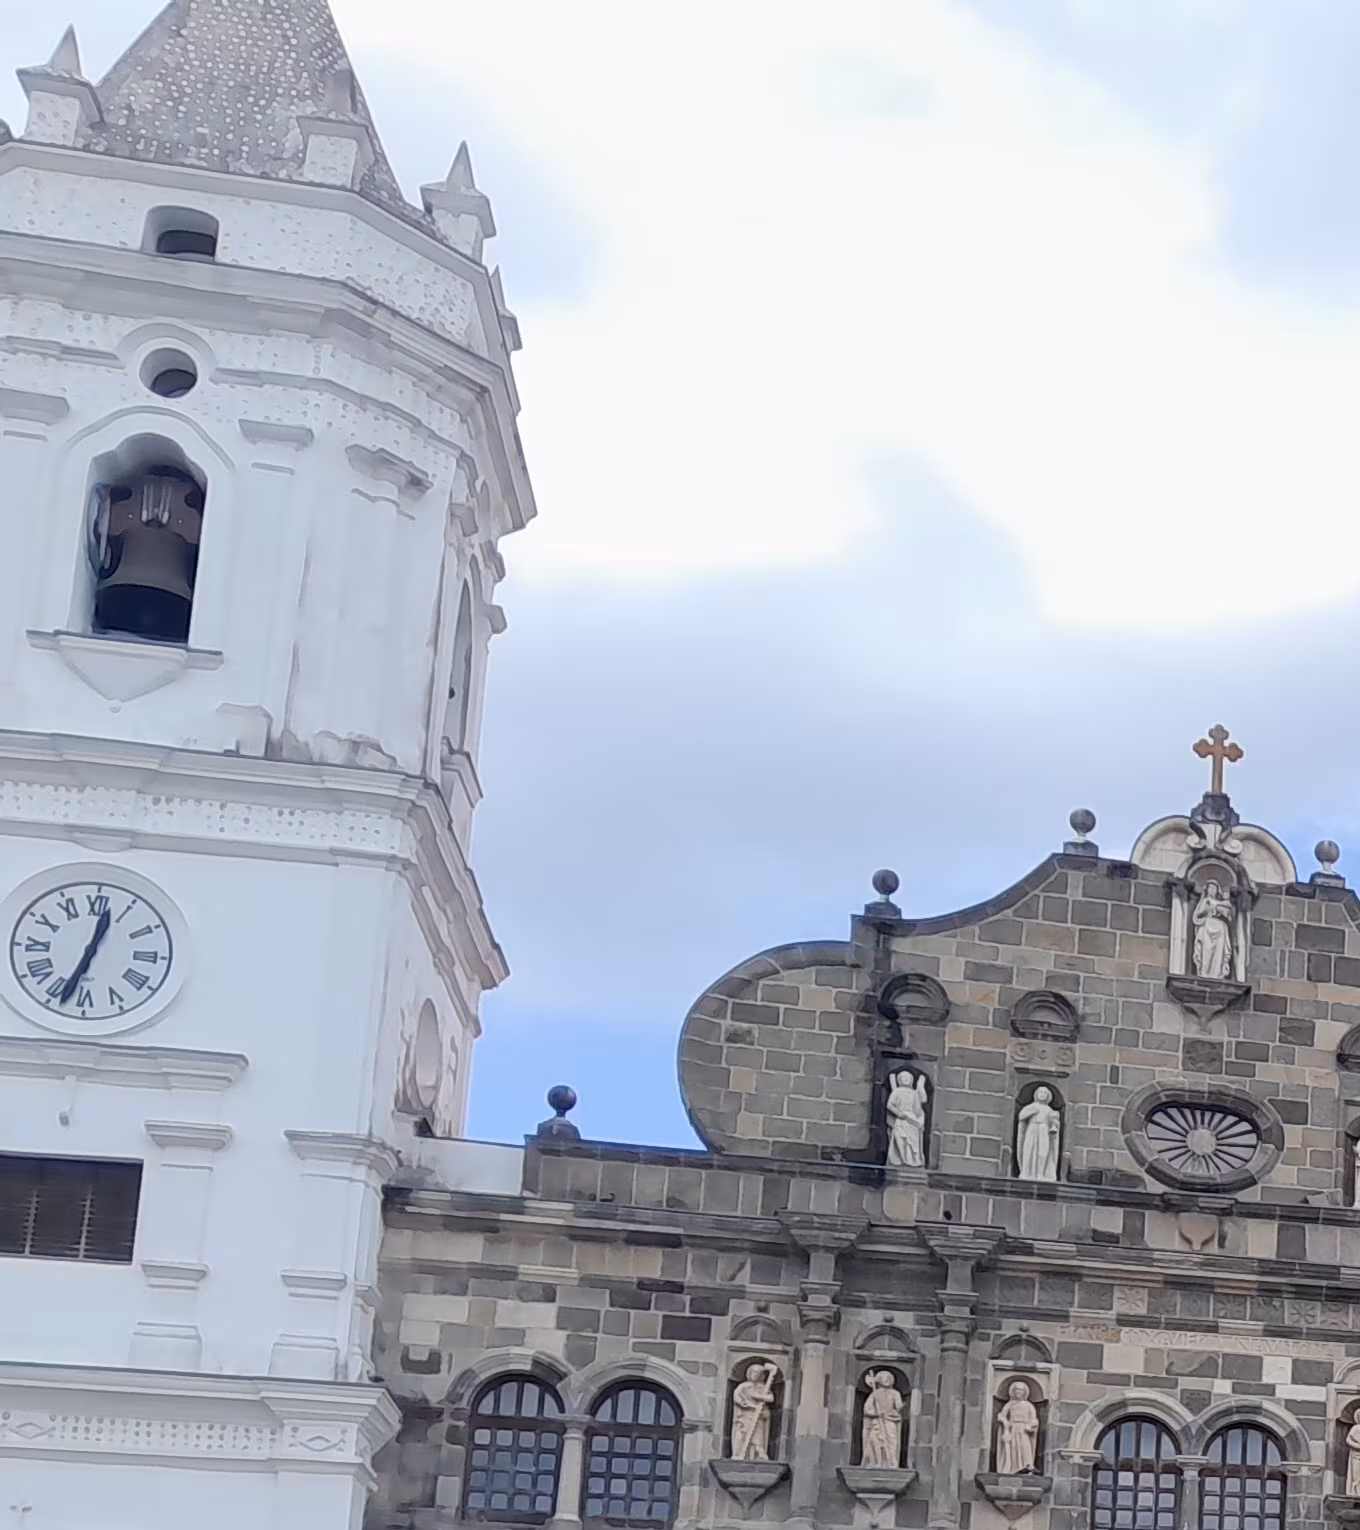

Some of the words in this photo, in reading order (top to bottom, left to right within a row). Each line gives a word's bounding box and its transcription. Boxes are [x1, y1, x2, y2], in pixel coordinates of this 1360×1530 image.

[56, 897, 79, 921] XI
[86, 894, 110, 916] XII
[35, 913, 60, 933] X
[25, 936, 51, 952] IX
[133, 951, 158, 964] III
[26, 958, 54, 985] VIII
[76, 985, 94, 1008] VI
[108, 986, 124, 1005] V
